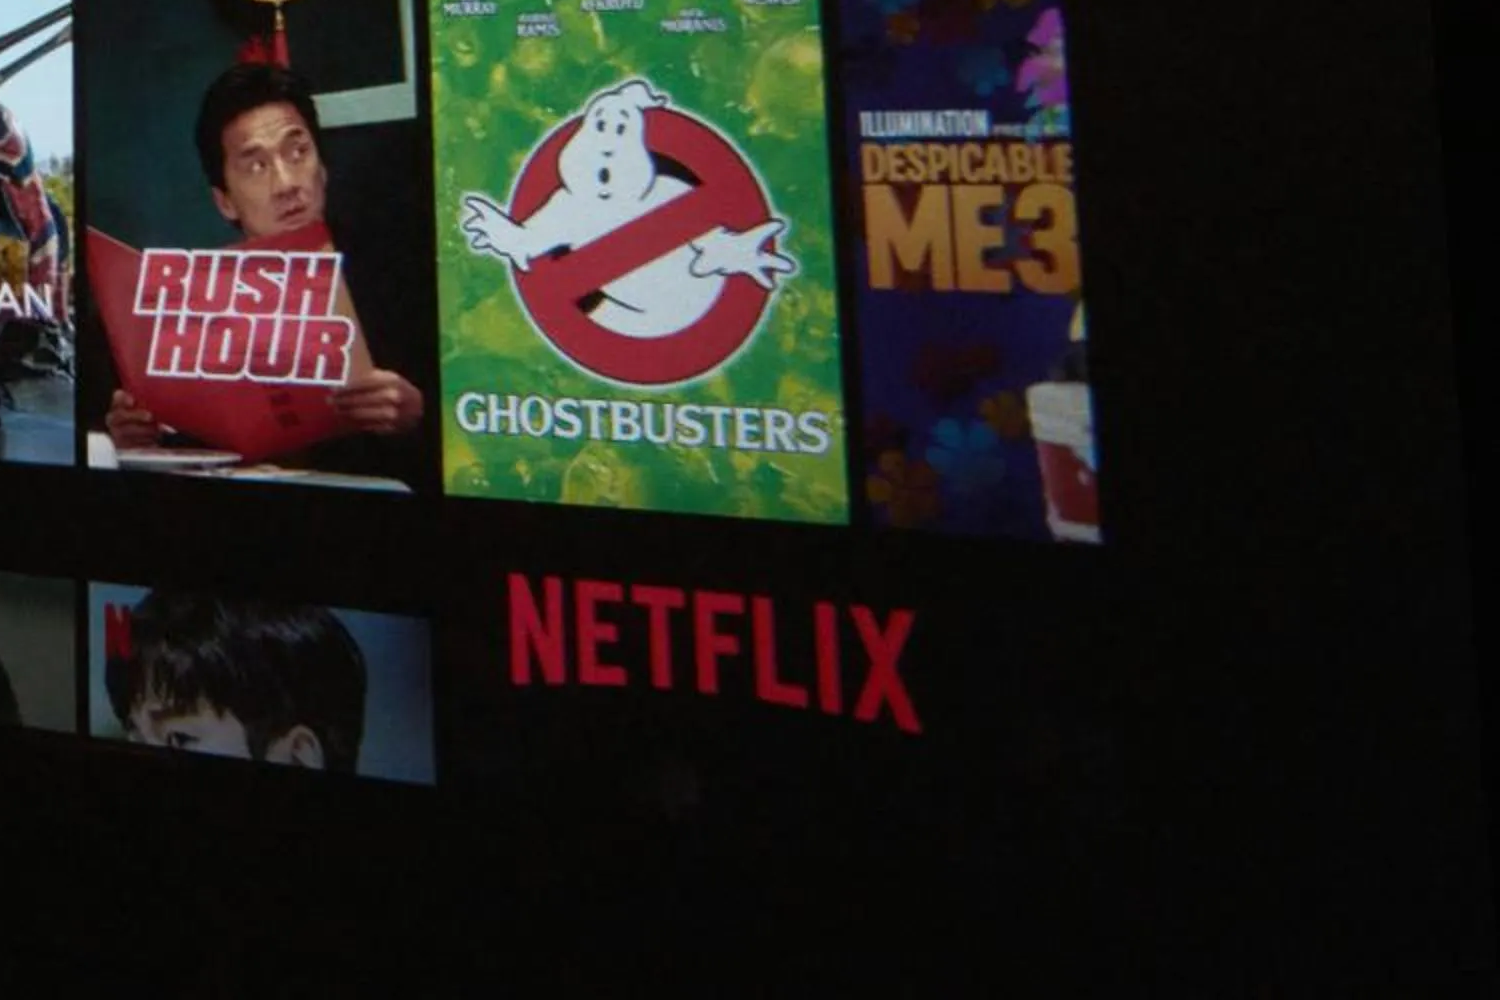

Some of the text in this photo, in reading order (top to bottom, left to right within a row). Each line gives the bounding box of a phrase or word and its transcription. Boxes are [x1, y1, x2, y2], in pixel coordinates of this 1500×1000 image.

[859, 109, 989, 137] ILLUMINATION
[861, 142, 1074, 184] DESPICABLE
[133, 247, 344, 320] RUSH
[146, 314, 356, 387] HOUR
[455, 391, 831, 455] GHOSTBUSTERS
[505, 571, 924, 735] NETFLIX
